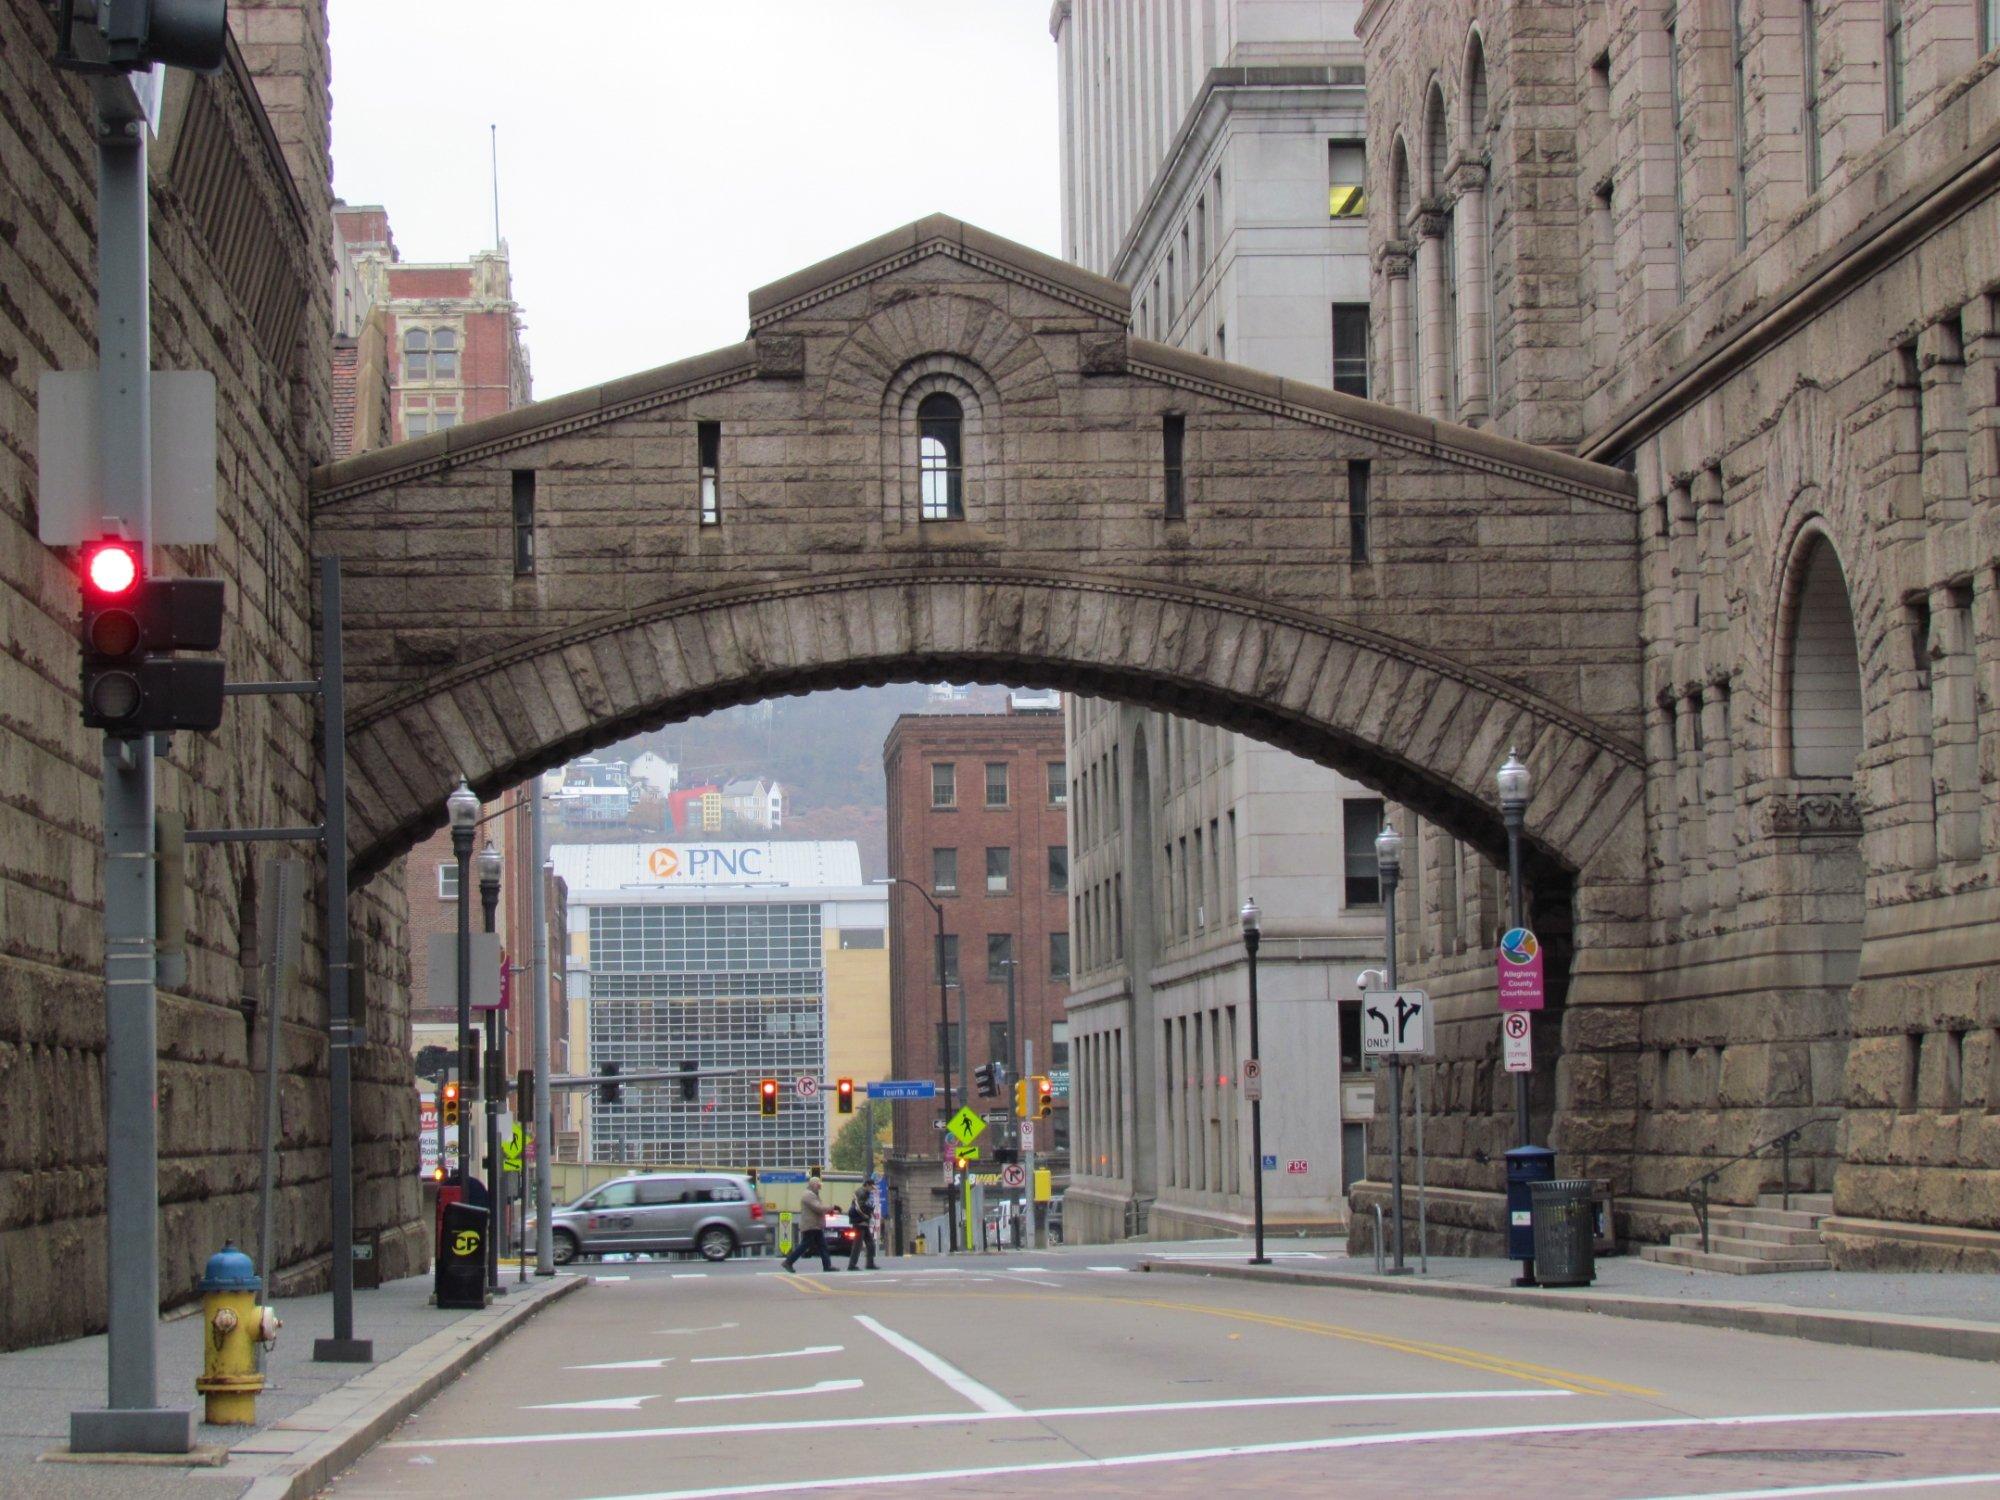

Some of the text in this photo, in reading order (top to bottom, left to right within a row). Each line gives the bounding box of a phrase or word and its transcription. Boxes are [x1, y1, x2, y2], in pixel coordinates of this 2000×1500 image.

[685, 848, 762, 875] PNC
[1504, 970, 1537, 979] Allegheny
[1508, 980, 1533, 988] County
[1367, 1039, 1389, 1047] ONLY
[883, 1088, 919, 1097] Fourth Ave
[1288, 1161, 1307, 1170] FDC
[954, 1173, 1002, 1186] SBWAY
[454, 1236, 480, 1250] CP
